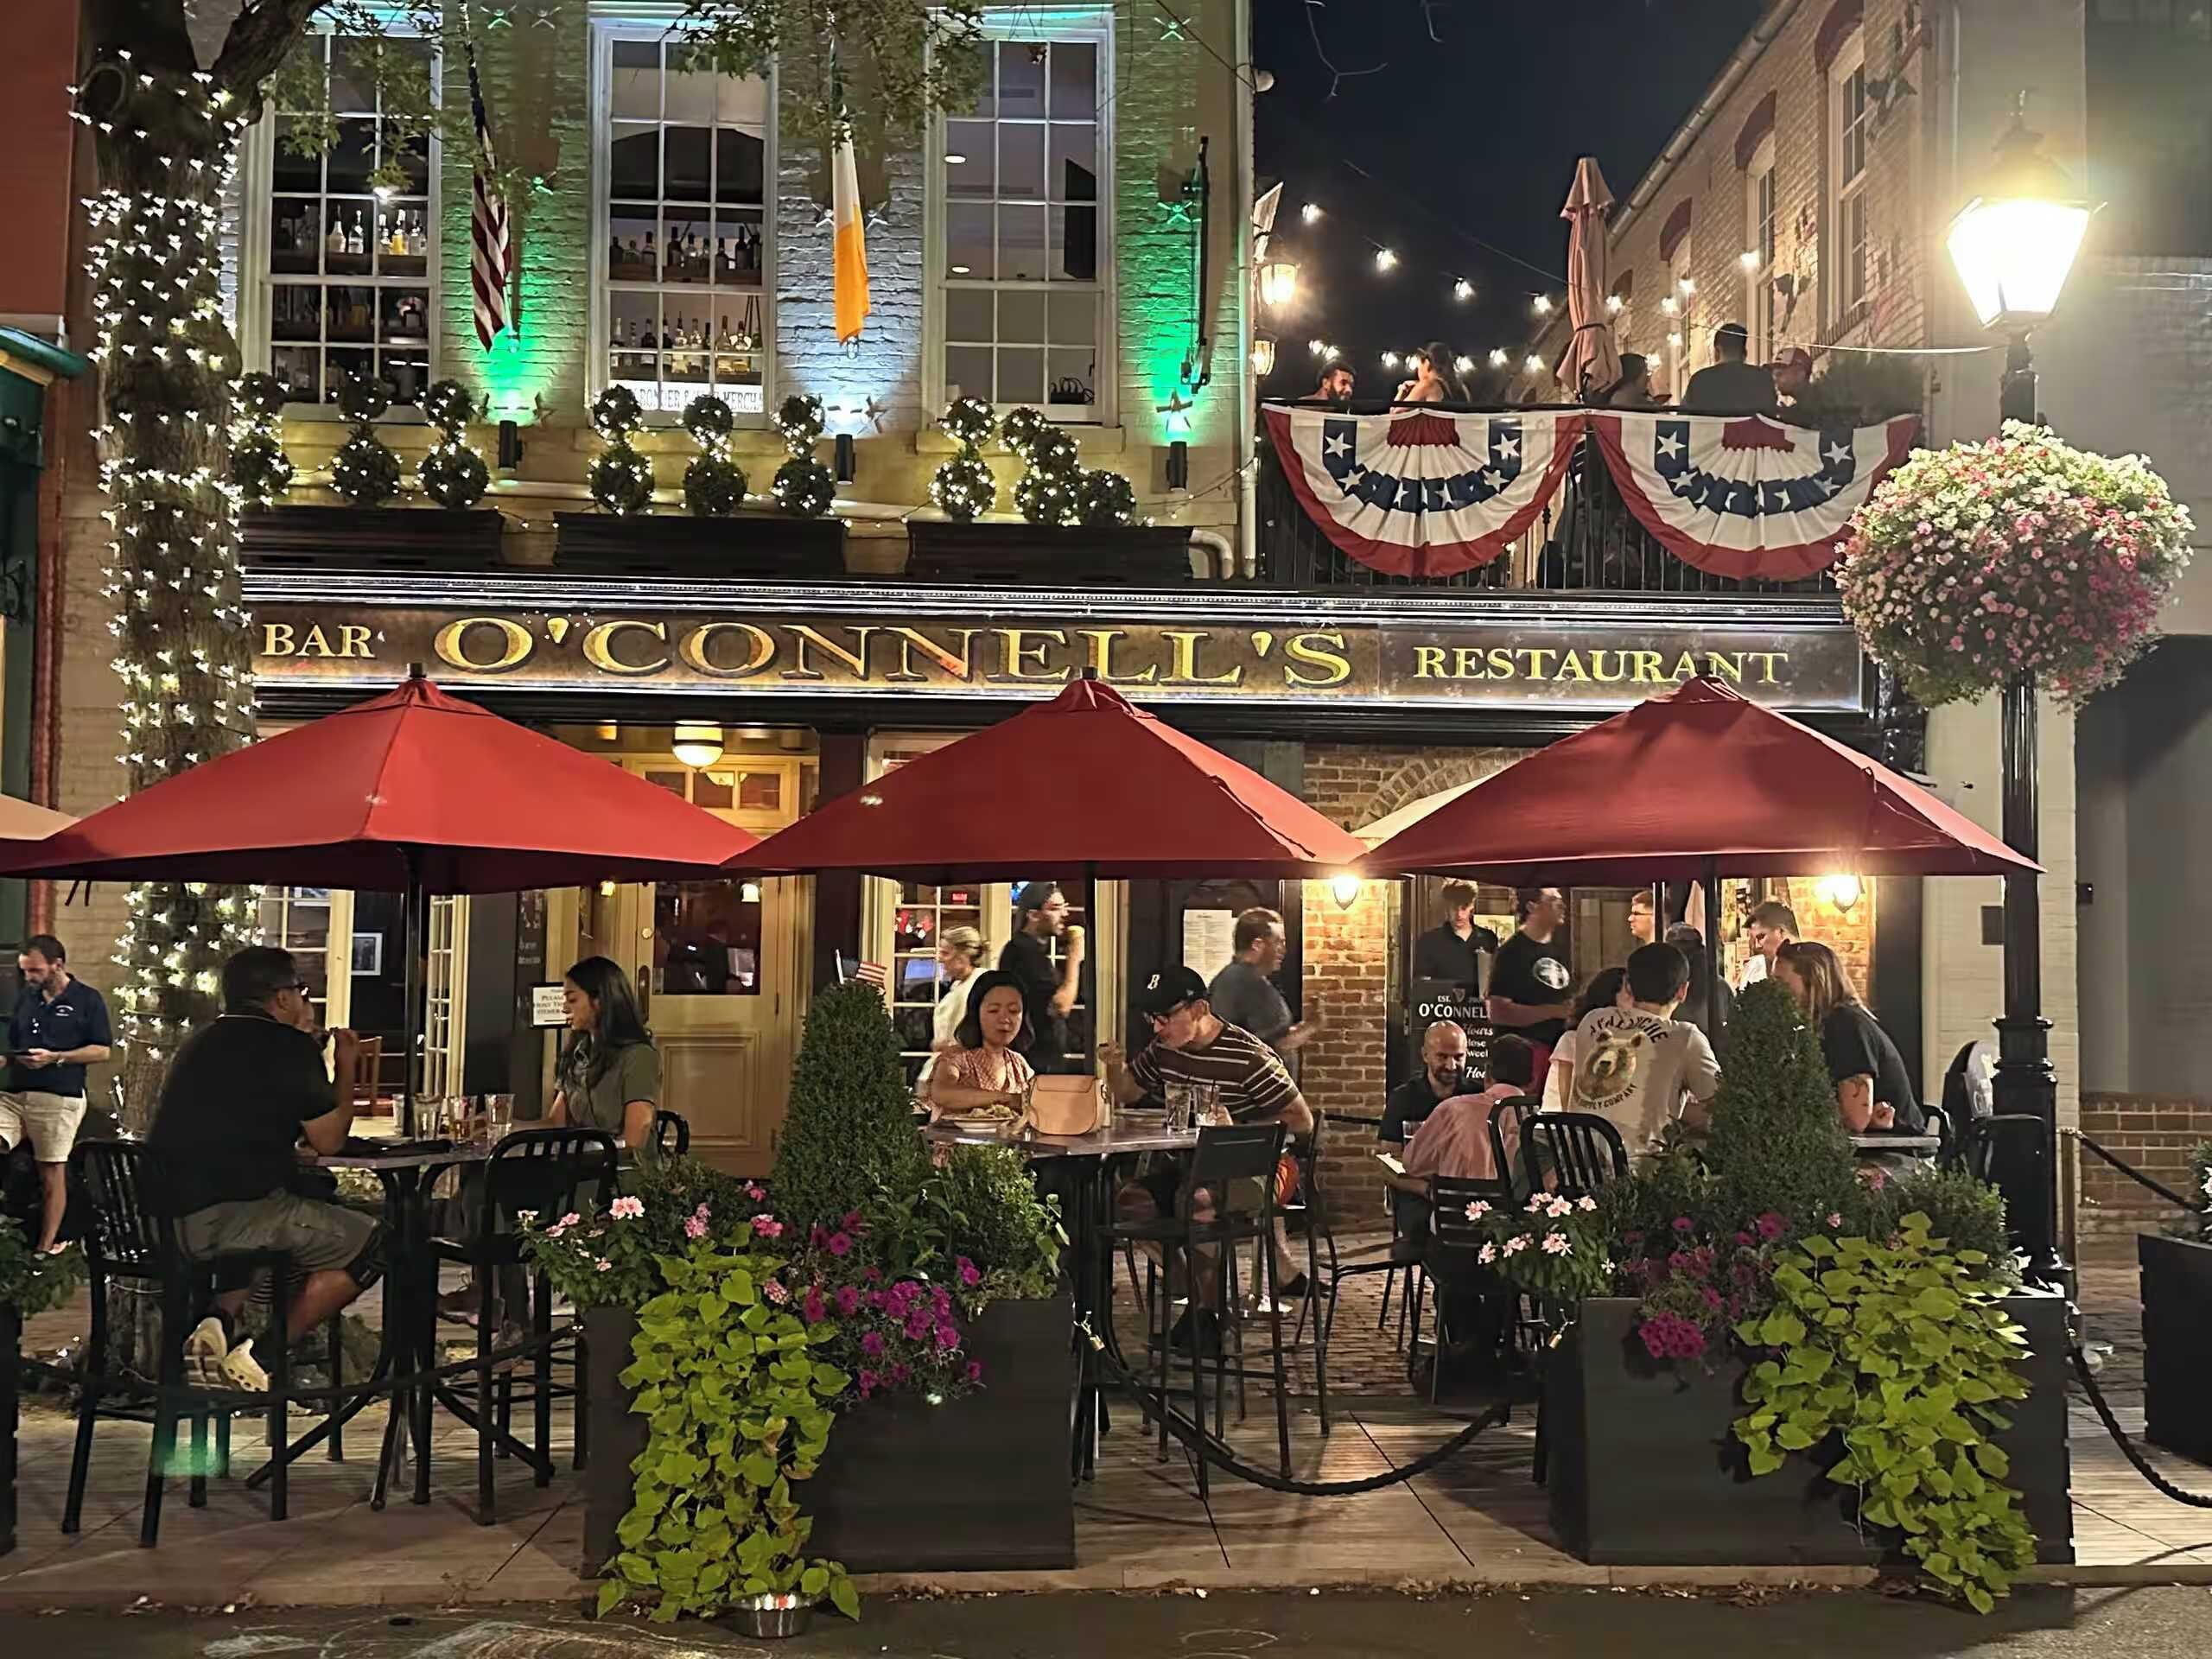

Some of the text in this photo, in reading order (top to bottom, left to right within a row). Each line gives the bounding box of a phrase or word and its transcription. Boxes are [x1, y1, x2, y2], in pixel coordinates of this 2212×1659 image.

[261, 615, 1789, 690] BAR O'CONNELL'S RESTAURANT
[1467, 1039, 1486, 1047] lose
